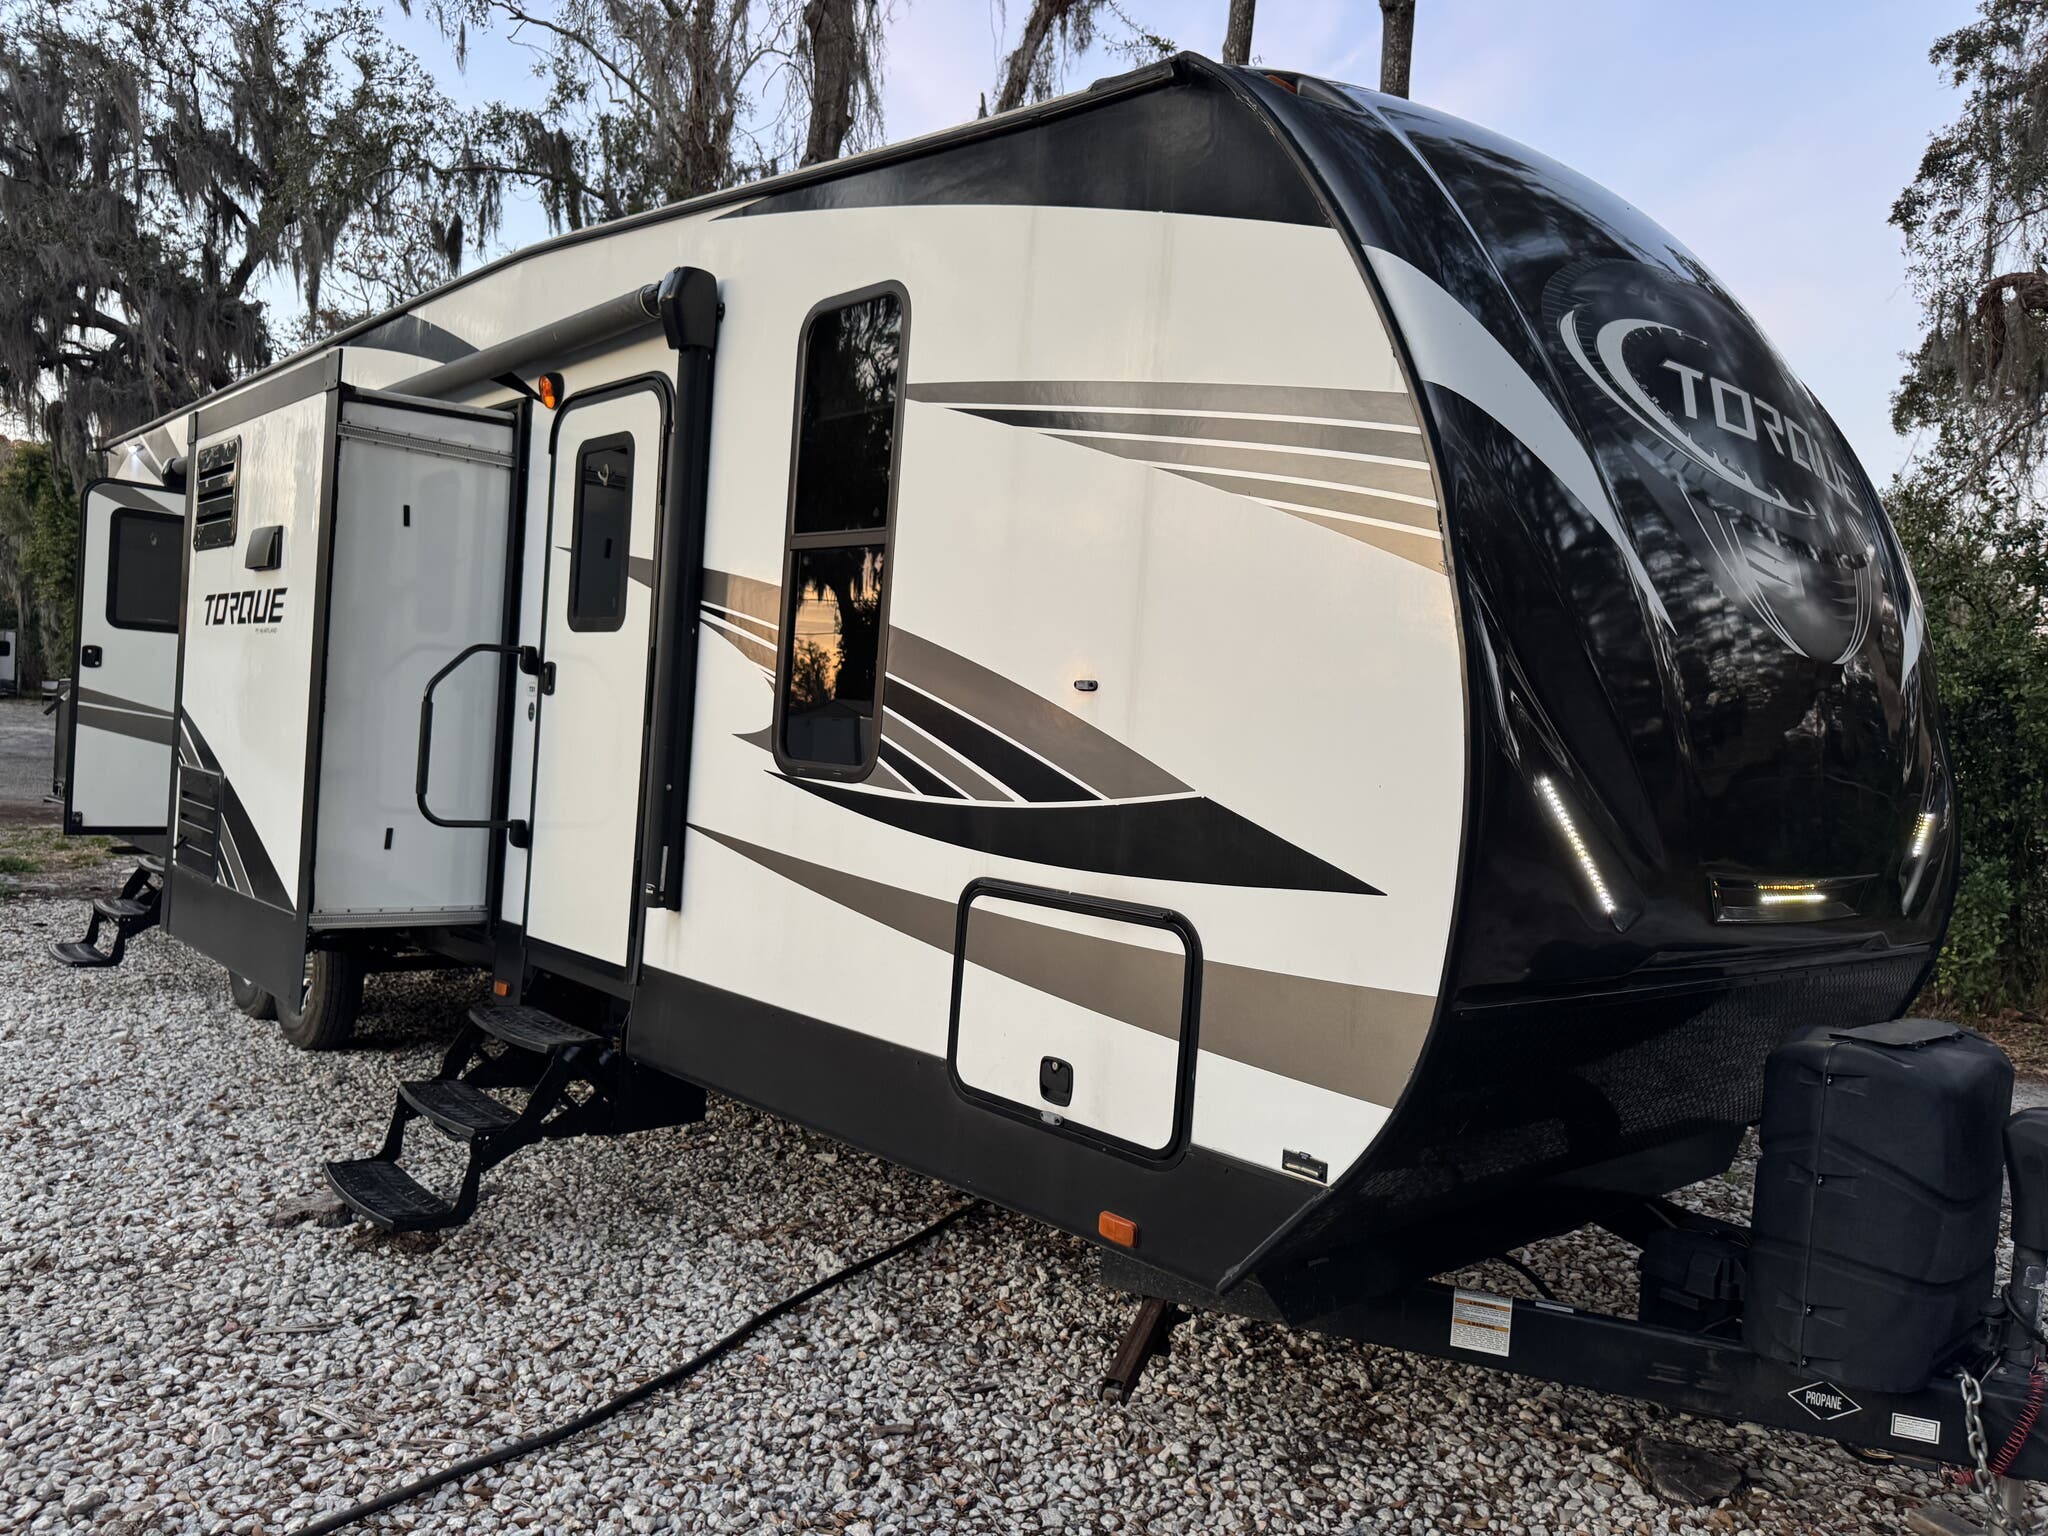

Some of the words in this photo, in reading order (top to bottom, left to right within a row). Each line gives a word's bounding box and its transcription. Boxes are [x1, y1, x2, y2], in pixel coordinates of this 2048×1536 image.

[1663, 359, 1863, 517] TORQUE
[204, 587, 288, 626] TORQUE
[1805, 1390, 1842, 1410] PROPANE
